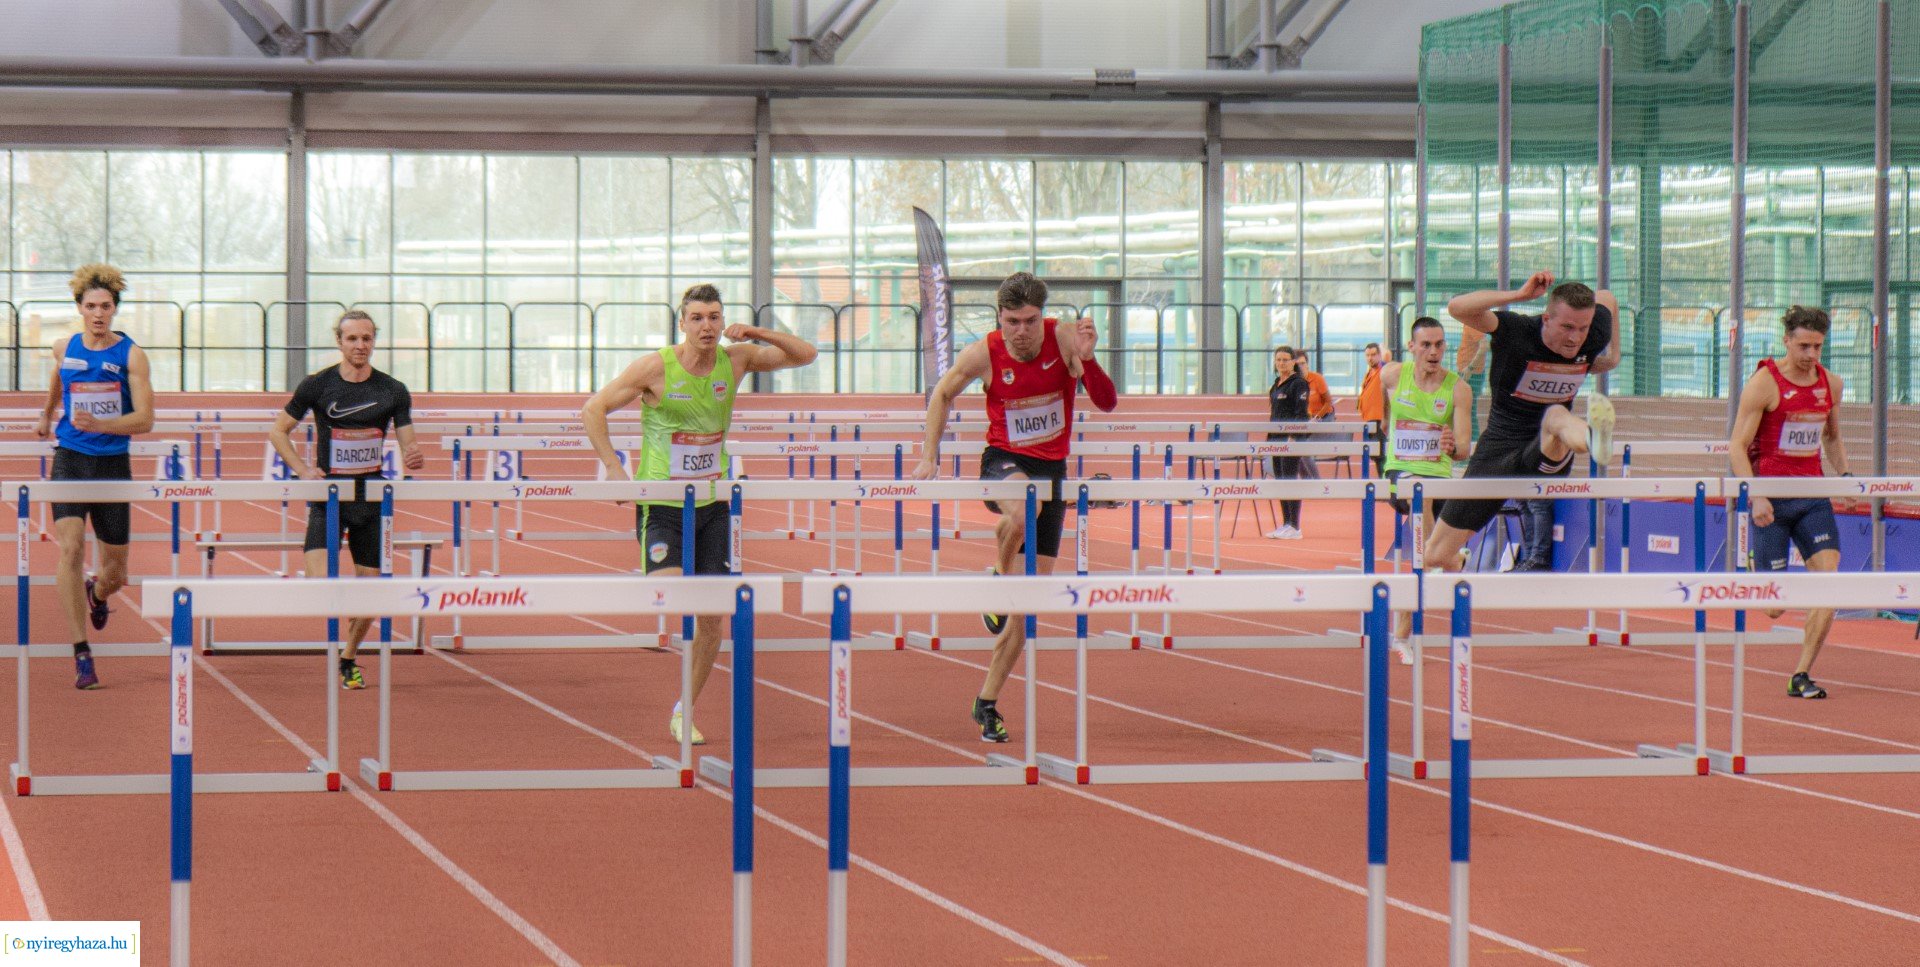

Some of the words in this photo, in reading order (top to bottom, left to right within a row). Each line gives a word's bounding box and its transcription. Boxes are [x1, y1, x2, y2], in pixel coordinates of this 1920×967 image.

[1528, 379, 1575, 394] SZELES
[1014, 415, 1048, 434] NAGY
[1050, 412, 1061, 427] R.
[549, 439, 582, 449] polanik
[787, 444, 819, 453] polanik
[1257, 445, 1289, 454] polanik
[1396, 437, 1440, 450] LOVISTYÉK
[336, 447, 379, 463] BARCZAI
[683, 453, 714, 472] ESZES
[382, 450, 397, 479] 4
[496, 450, 514, 480] 3
[164, 485, 213, 498] polanik
[525, 485, 573, 498] polanik
[870, 484, 917, 496] polanik
[1213, 484, 1260, 496] polanik
[1546, 483, 1591, 495] polanik
[1869, 482, 1913, 494] polanik
[438, 585, 528, 611] polanik
[1088, 584, 1174, 607] polanik
[1699, 580, 1782, 603] polanik
[836, 666, 848, 719] polanik
[1457, 663, 1471, 713] polanik
[178, 674, 189, 727] polanik
